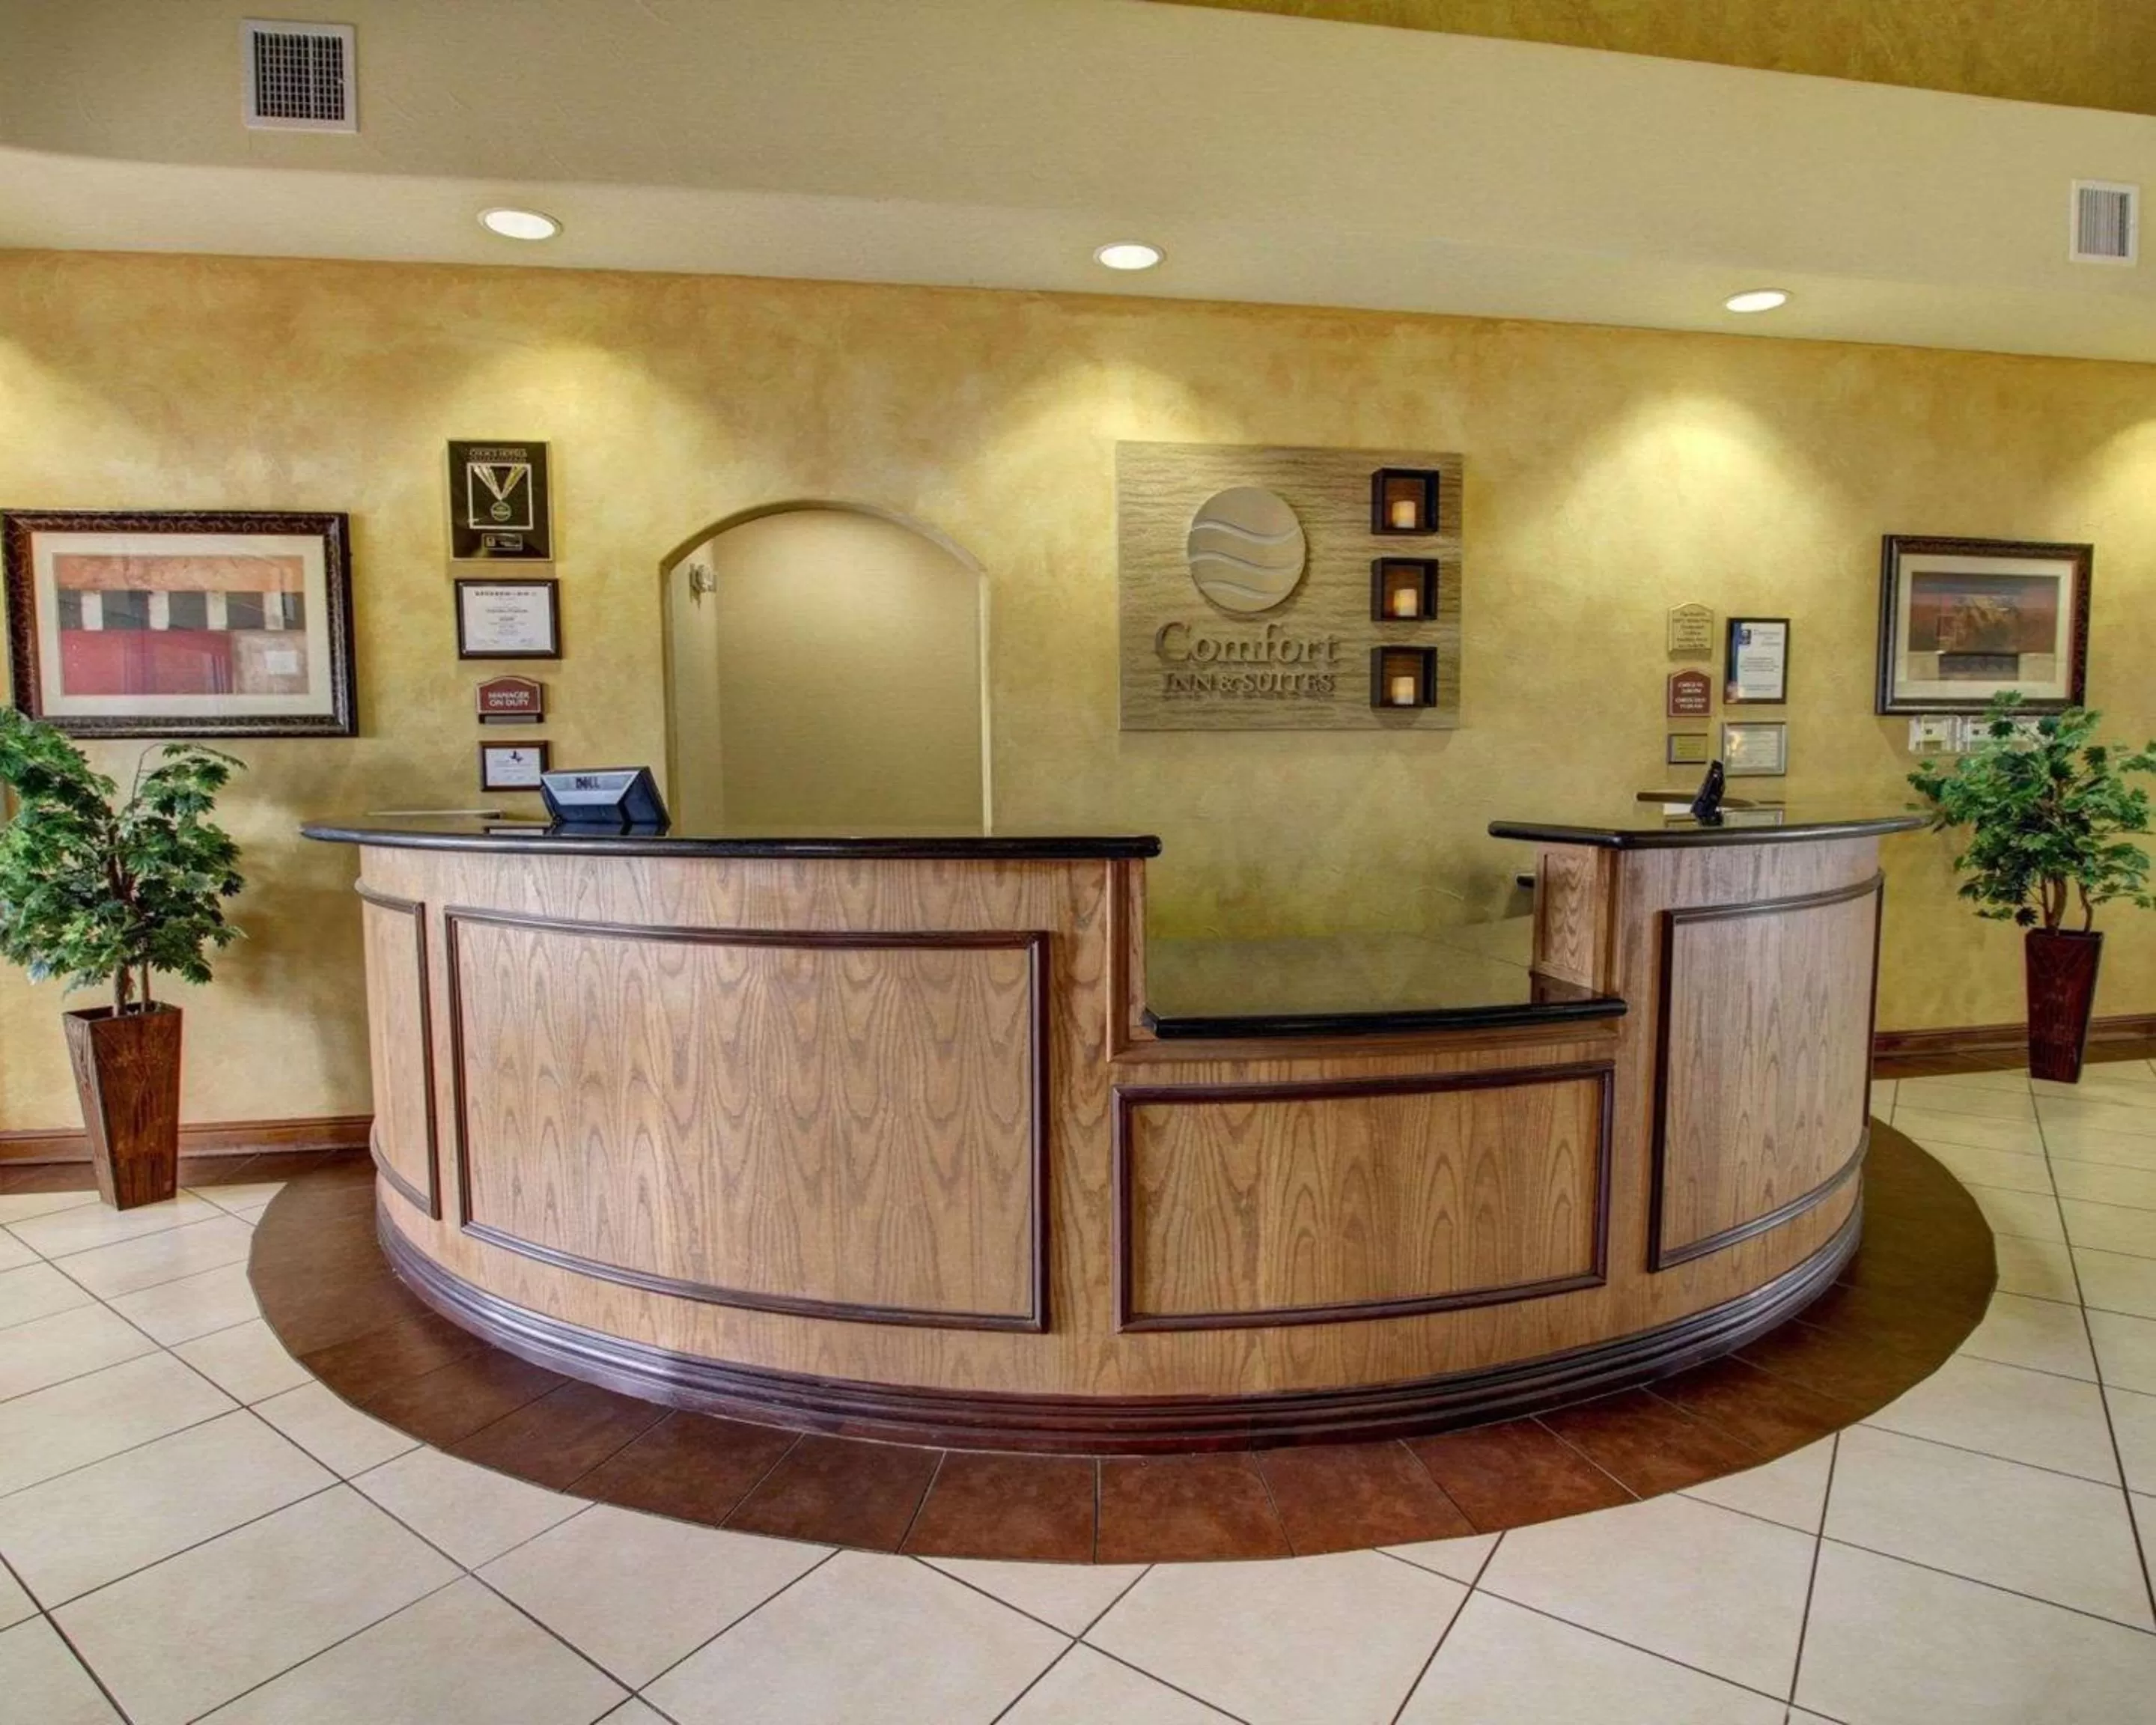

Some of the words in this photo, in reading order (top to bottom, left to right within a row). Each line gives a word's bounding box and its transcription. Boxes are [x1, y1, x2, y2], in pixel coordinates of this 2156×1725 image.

[1155, 621, 1342, 663] Comfort
[1164, 672, 1213, 693] INN
[1219, 675, 1237, 692] &
[1242, 672, 1336, 693] SUITES
[487, 691, 530, 699] MANAGER
[490, 699, 504, 707] ON
[505, 699, 529, 707] DUTY
[575, 776, 600, 789] DELL
